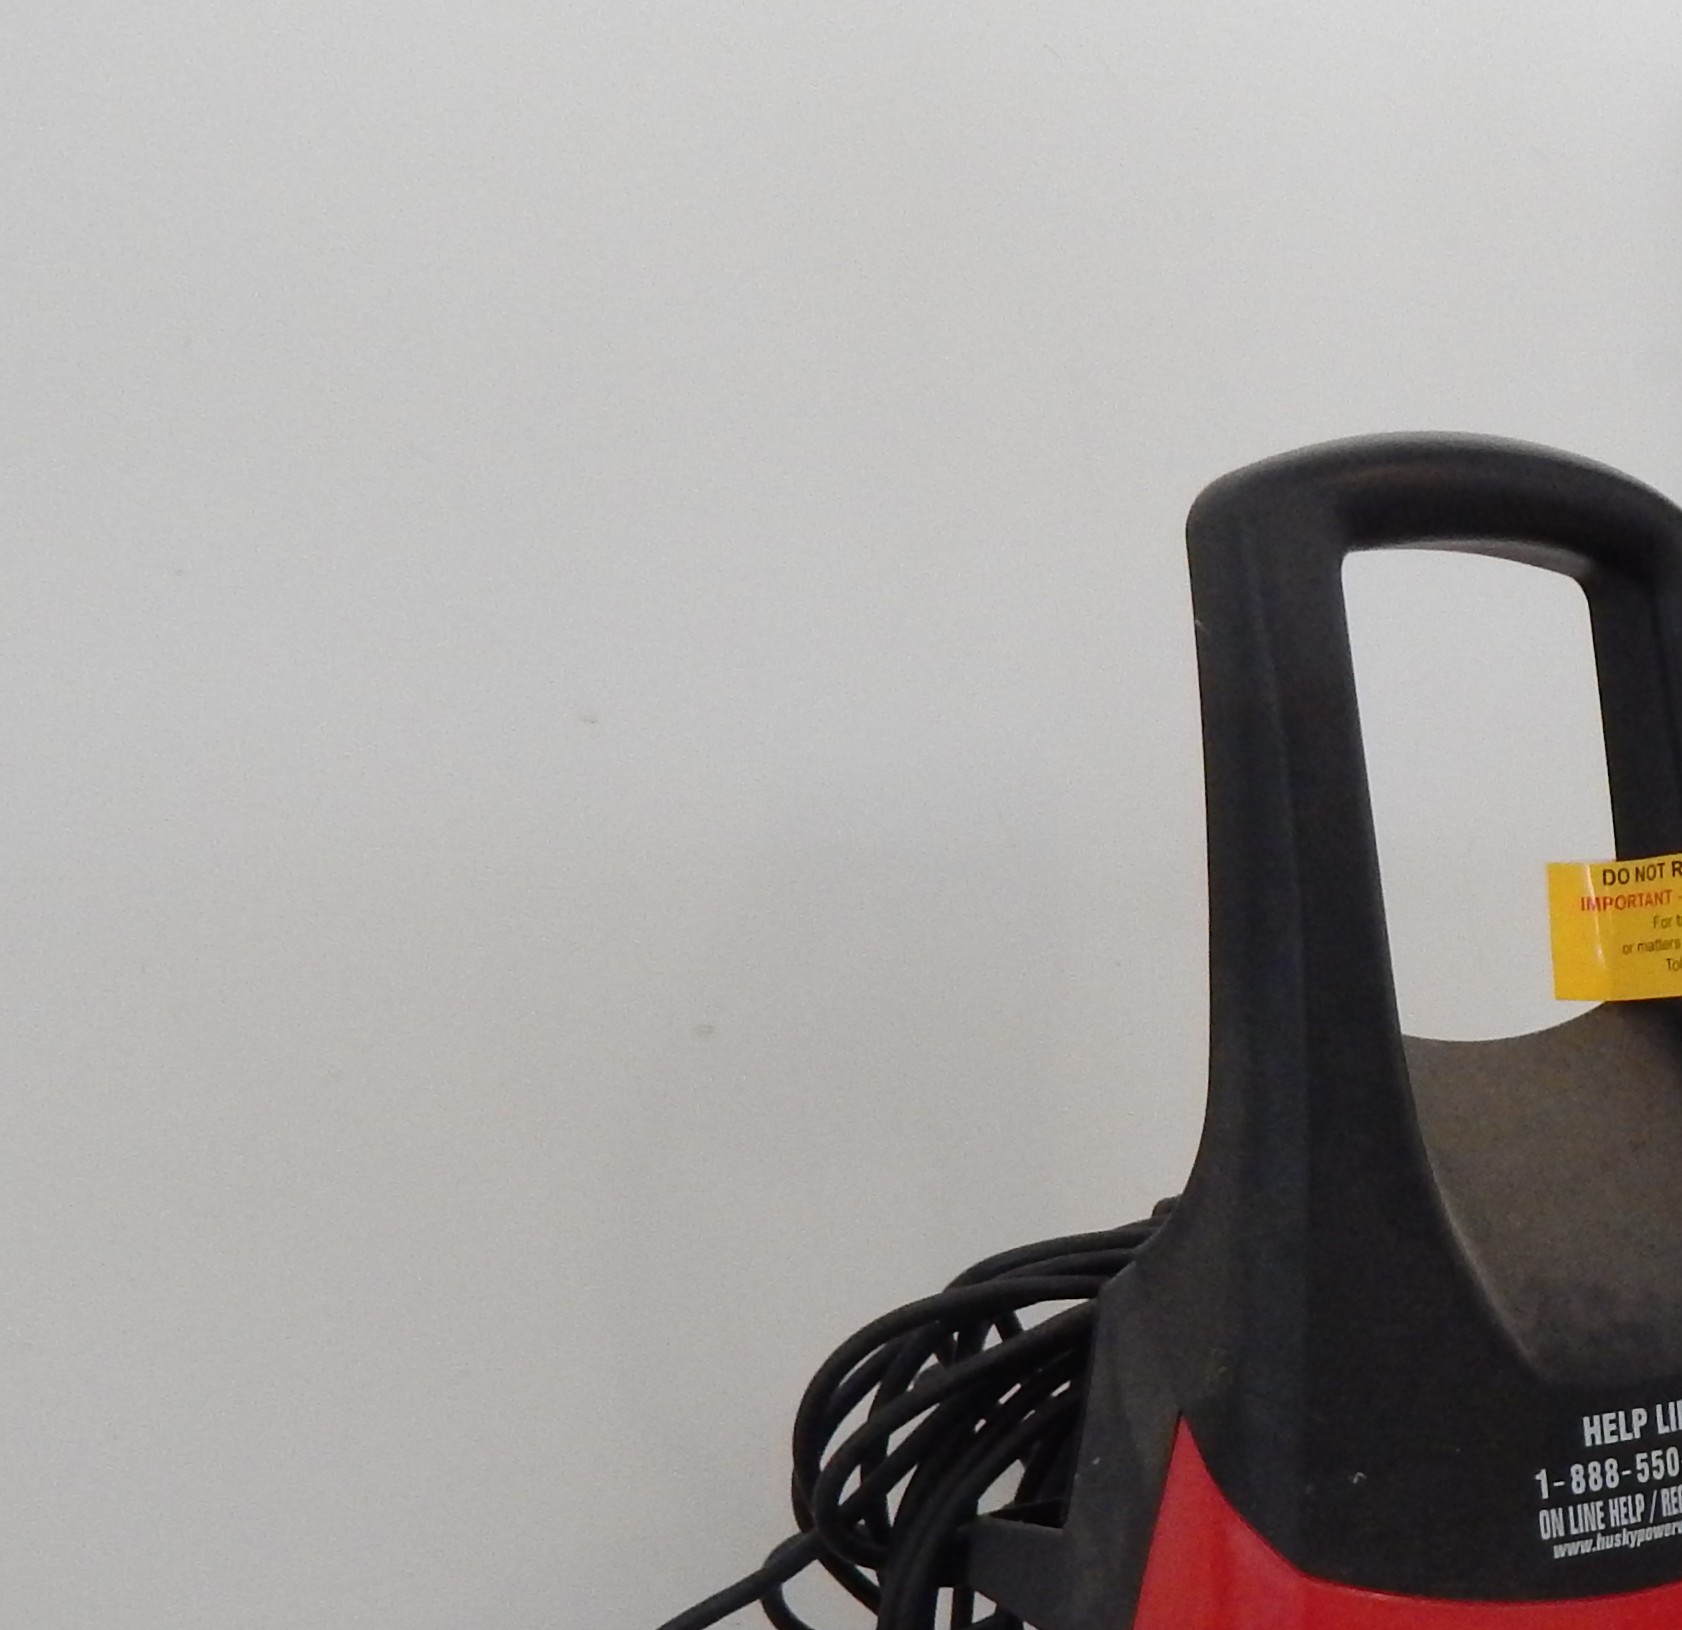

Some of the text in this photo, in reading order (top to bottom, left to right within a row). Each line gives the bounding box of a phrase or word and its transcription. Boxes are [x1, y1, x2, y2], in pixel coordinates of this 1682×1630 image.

[1603, 867, 1630, 886] DO
[1635, 862, 1665, 882] NOT
[1581, 889, 1672, 911] IMPORTANT
[1653, 914, 1673, 929] For
[1622, 943, 1635, 955] or
[1638, 939, 1681, 953] matters
[1582, 1407, 1648, 1447] HELP
[1538, 1506, 1565, 1540] ON
[1568, 1500, 1606, 1535] LINE
[1608, 1493, 1645, 1528] HELP
[1649, 1489, 1657, 1524] /
